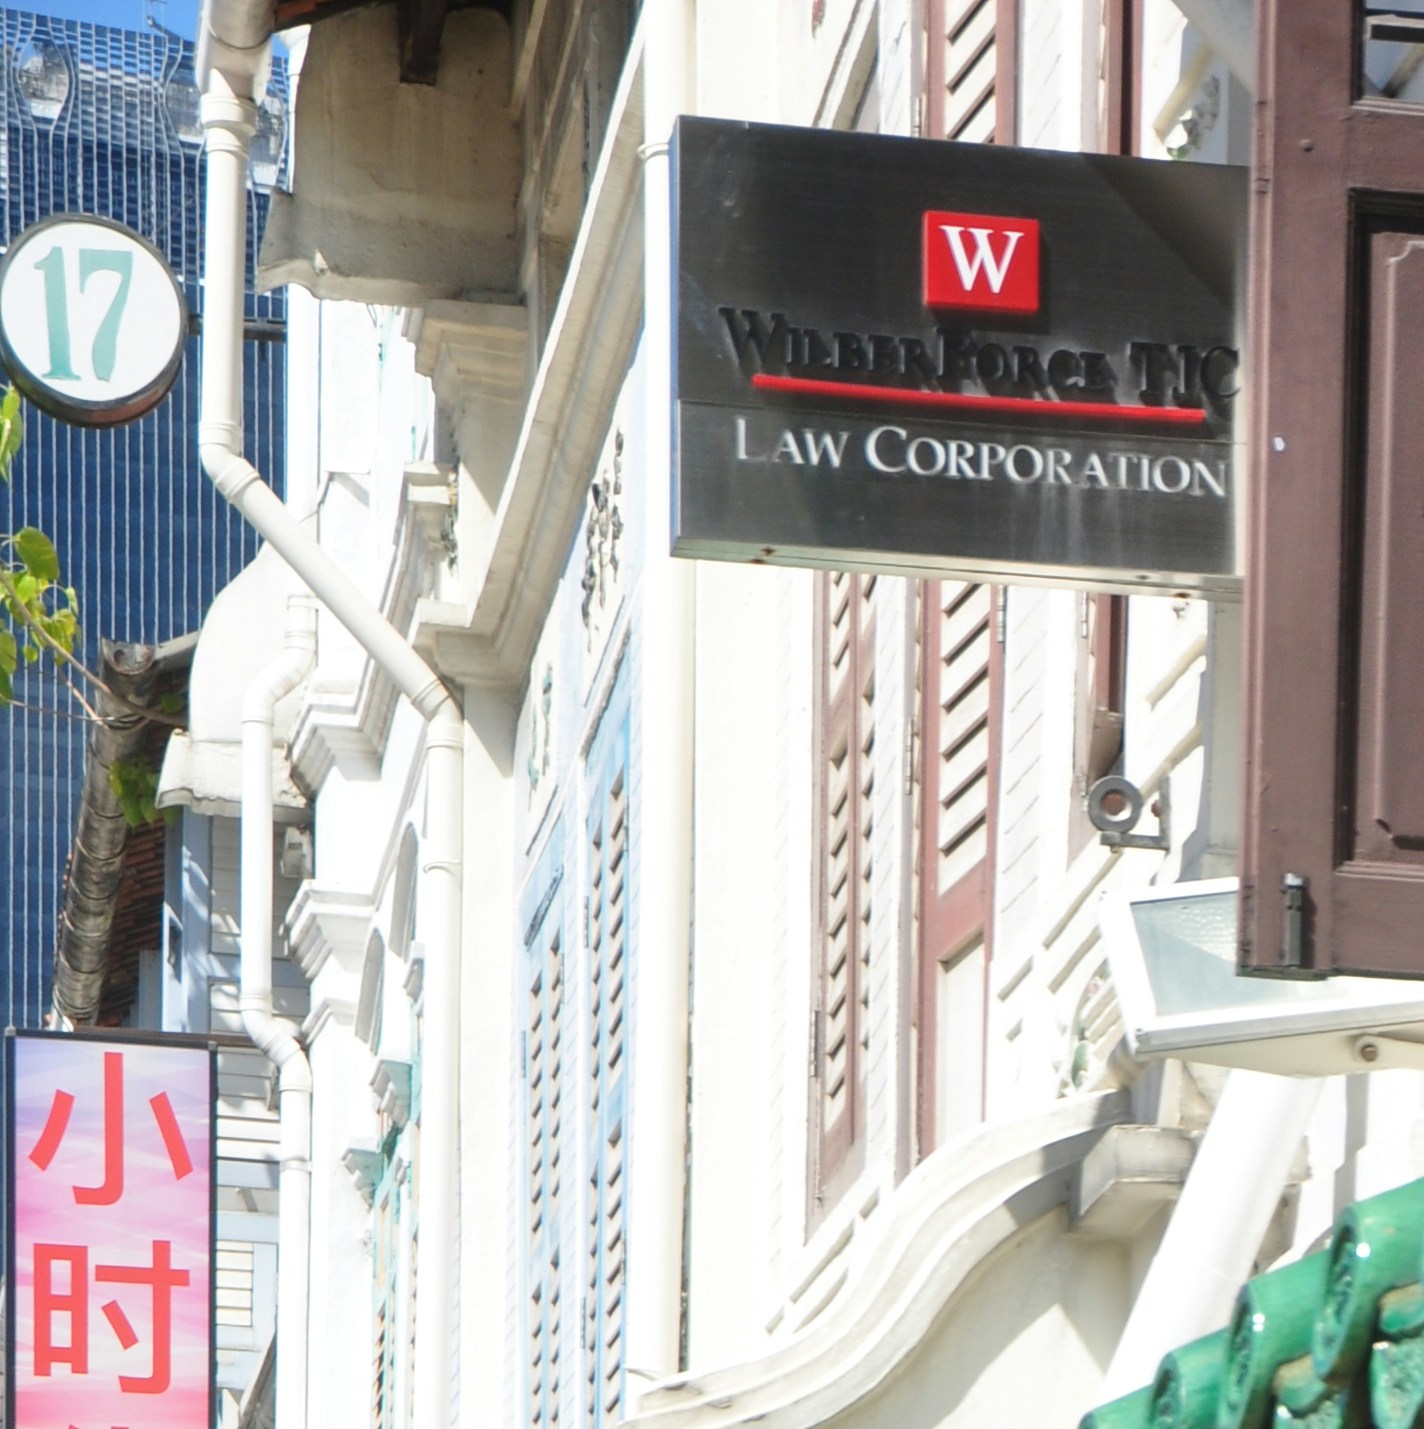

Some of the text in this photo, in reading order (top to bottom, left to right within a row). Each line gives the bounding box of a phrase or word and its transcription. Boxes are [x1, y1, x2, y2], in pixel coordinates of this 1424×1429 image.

[939, 223, 1027, 295] W
[32, 245, 135, 383] 17
[734, 416, 1228, 499] LAW CORPORATION
